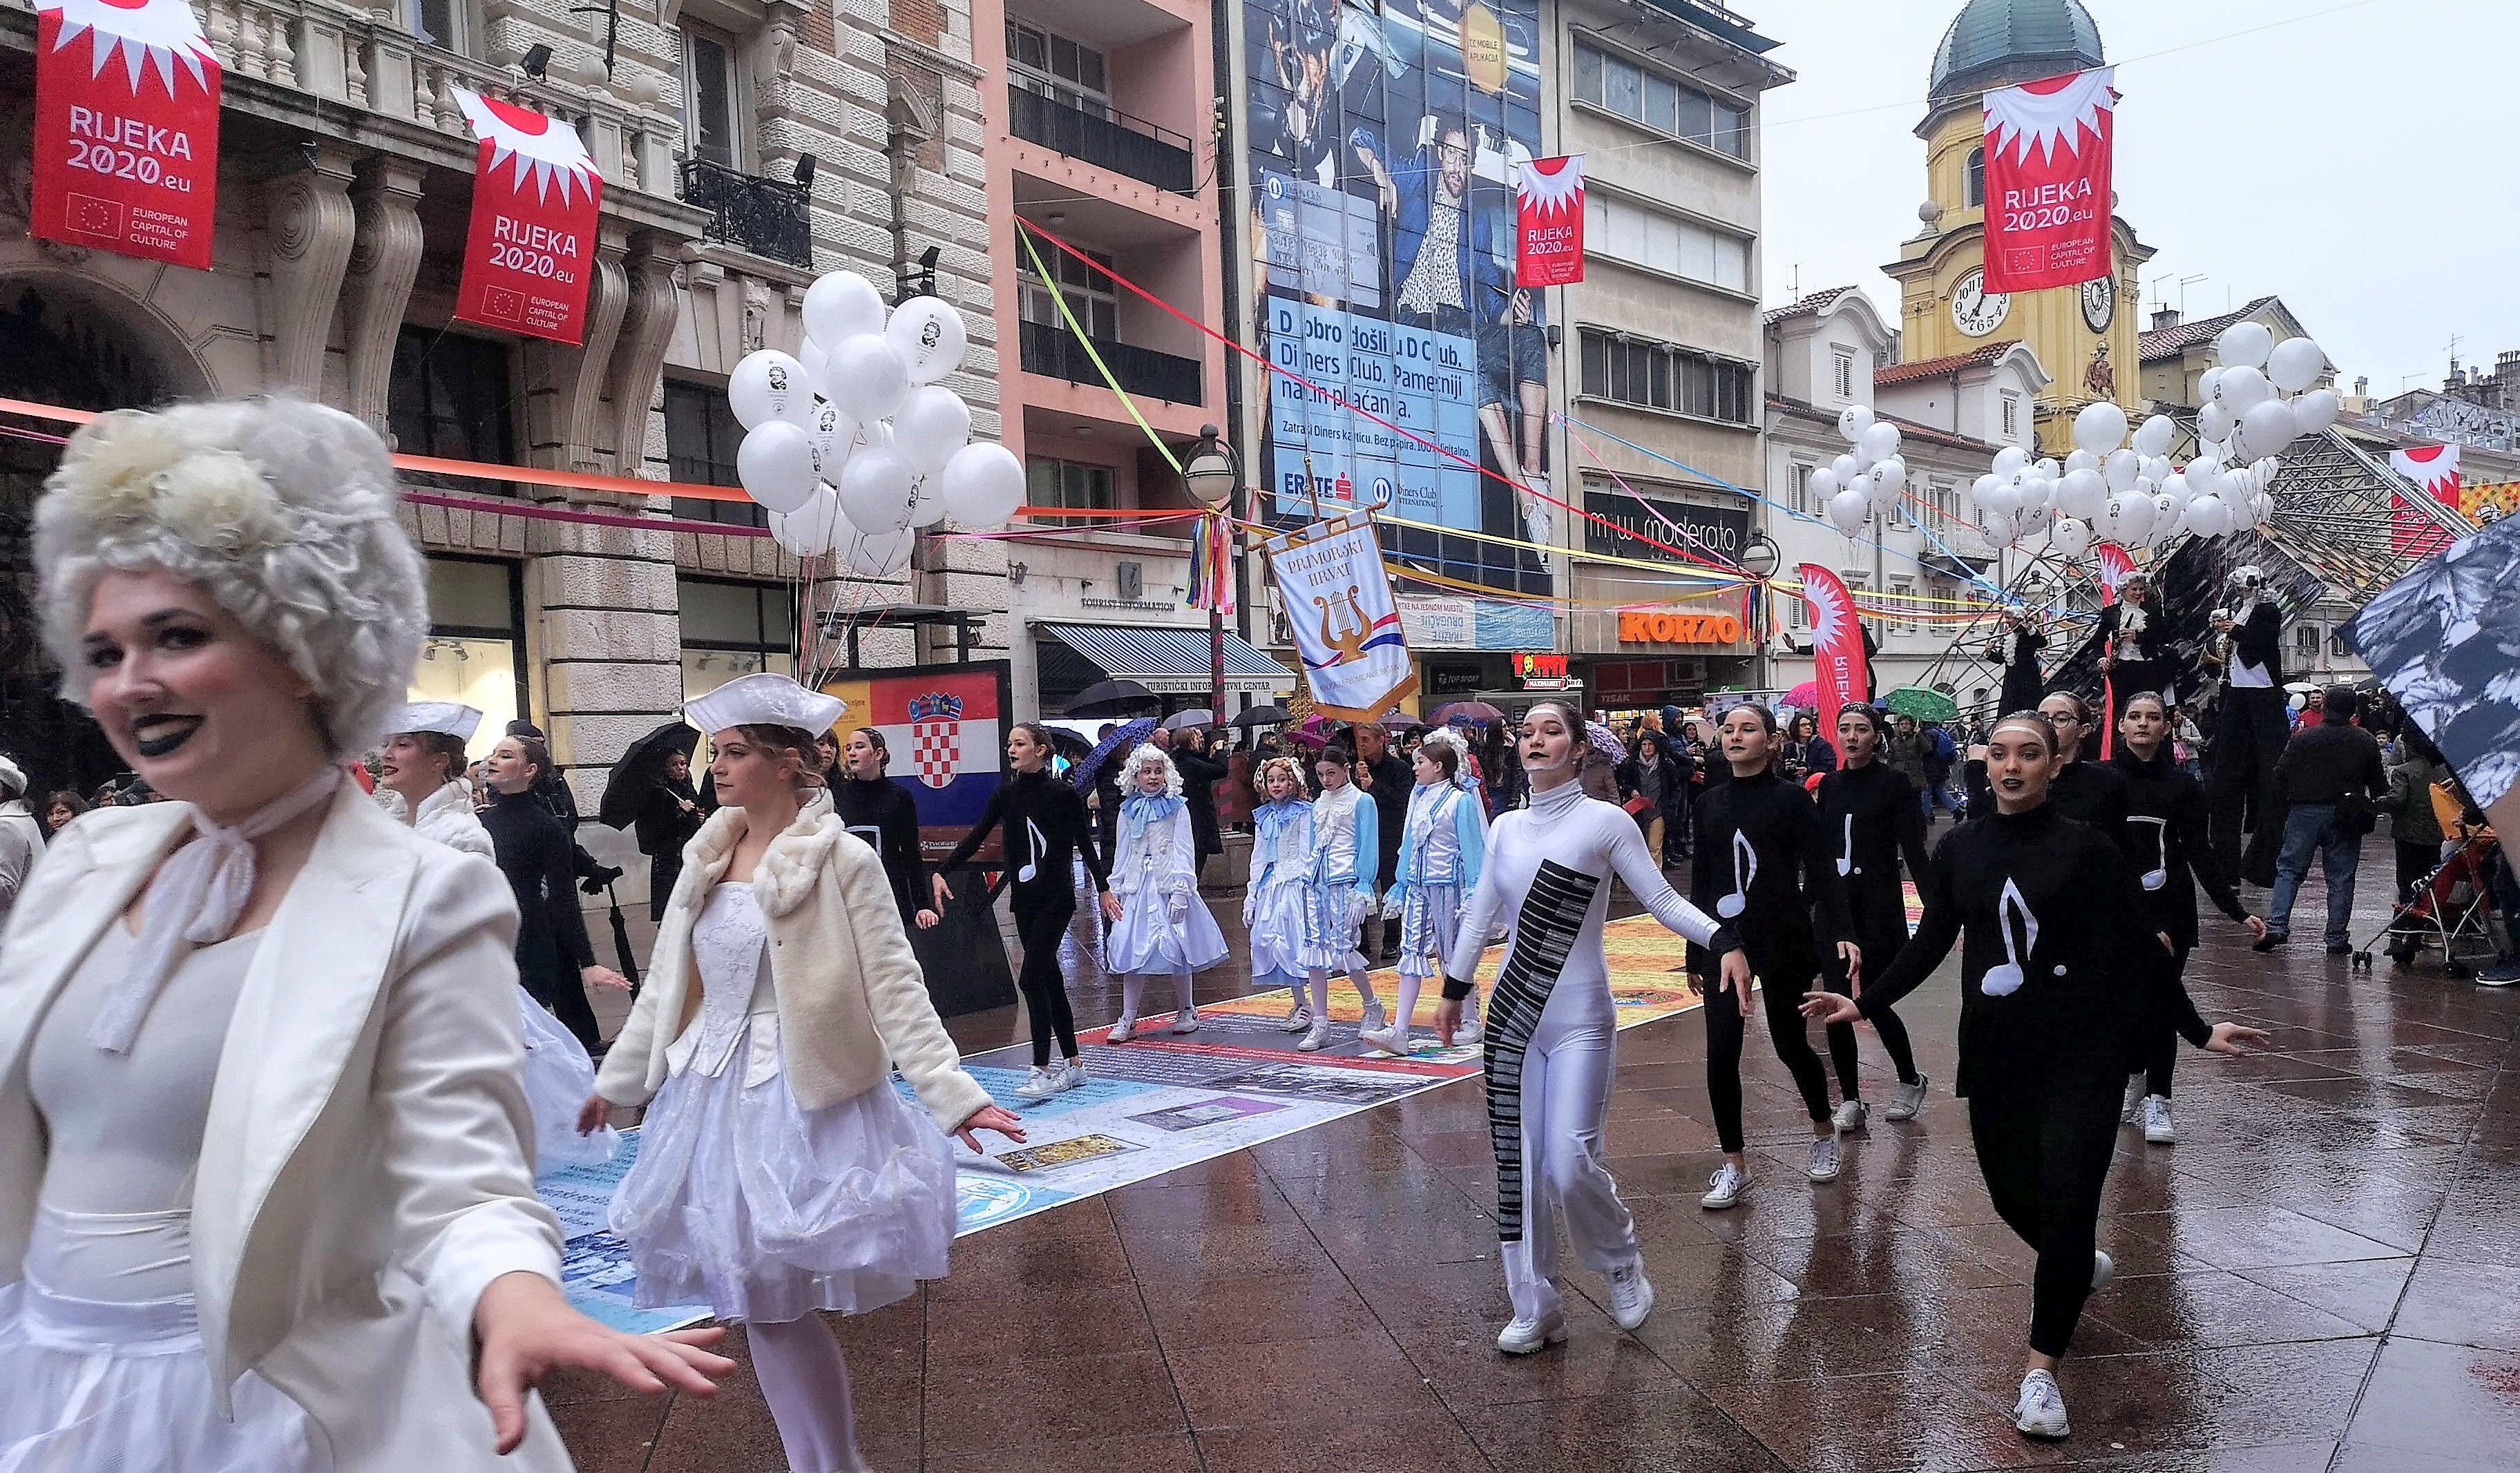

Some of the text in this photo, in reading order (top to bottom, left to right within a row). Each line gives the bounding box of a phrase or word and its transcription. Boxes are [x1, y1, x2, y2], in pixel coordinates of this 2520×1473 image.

[70, 104, 192, 161] RIJEKA
[67, 139, 191, 193] 2020.eu
[2005, 177, 2092, 209] RIJEKA
[133, 206, 188, 227] EUROPEAN
[2003, 205, 2093, 232] 2020.eu
[131, 220, 189, 239] CAPITAL OF
[494, 215, 578, 258] RIJEKA
[1527, 226, 1573, 242] RIJEKA
[130, 233, 177, 250] CULTURE
[1527, 240, 1574, 255] 2020.eu
[2051, 237, 2094, 251] EUROPEAN
[2050, 247, 2095, 260] CAPITAL OF
[489, 242, 575, 284] 2020.eu
[2051, 257, 2087, 269] CULTURE
[1969, 279, 1975, 292] 11
[1959, 287, 1968, 300] 10
[1999, 293, 2007, 305] 3
[531, 296, 569, 311] EUROPEAN
[1955, 301, 1963, 314] 9
[1995, 305, 2002, 316] 4
[528, 307, 569, 321] CAPITAL OF
[1960, 312, 1967, 325] 8
[1986, 314, 1994, 327] 5
[526, 317, 558, 330] CULTURE
[1969, 319, 1976, 331] 7
[1977, 319, 1985, 331] 6
[1407, 337, 1418, 358] D
[1422, 340, 1462, 367] Cub.
[1314, 425, 1340, 440] Diners
[1374, 434, 1388, 446] Bez
[1397, 483, 1437, 499] Diners Club
[1644, 515, 1736, 551] moderato
[1287, 539, 1364, 574] PRIMORSKI
[1306, 561, 1351, 588] HRVAT
[1081, 597, 1176, 612] TOURIST INFORMATION
[1420, 603, 1442, 612] JEDNOM
[1619, 612, 1740, 644] KORZO
[1146, 680, 1270, 691] TURISTIČKI INFORTIVNI CENTAR
[1601, 693, 1630, 702] TISAK
